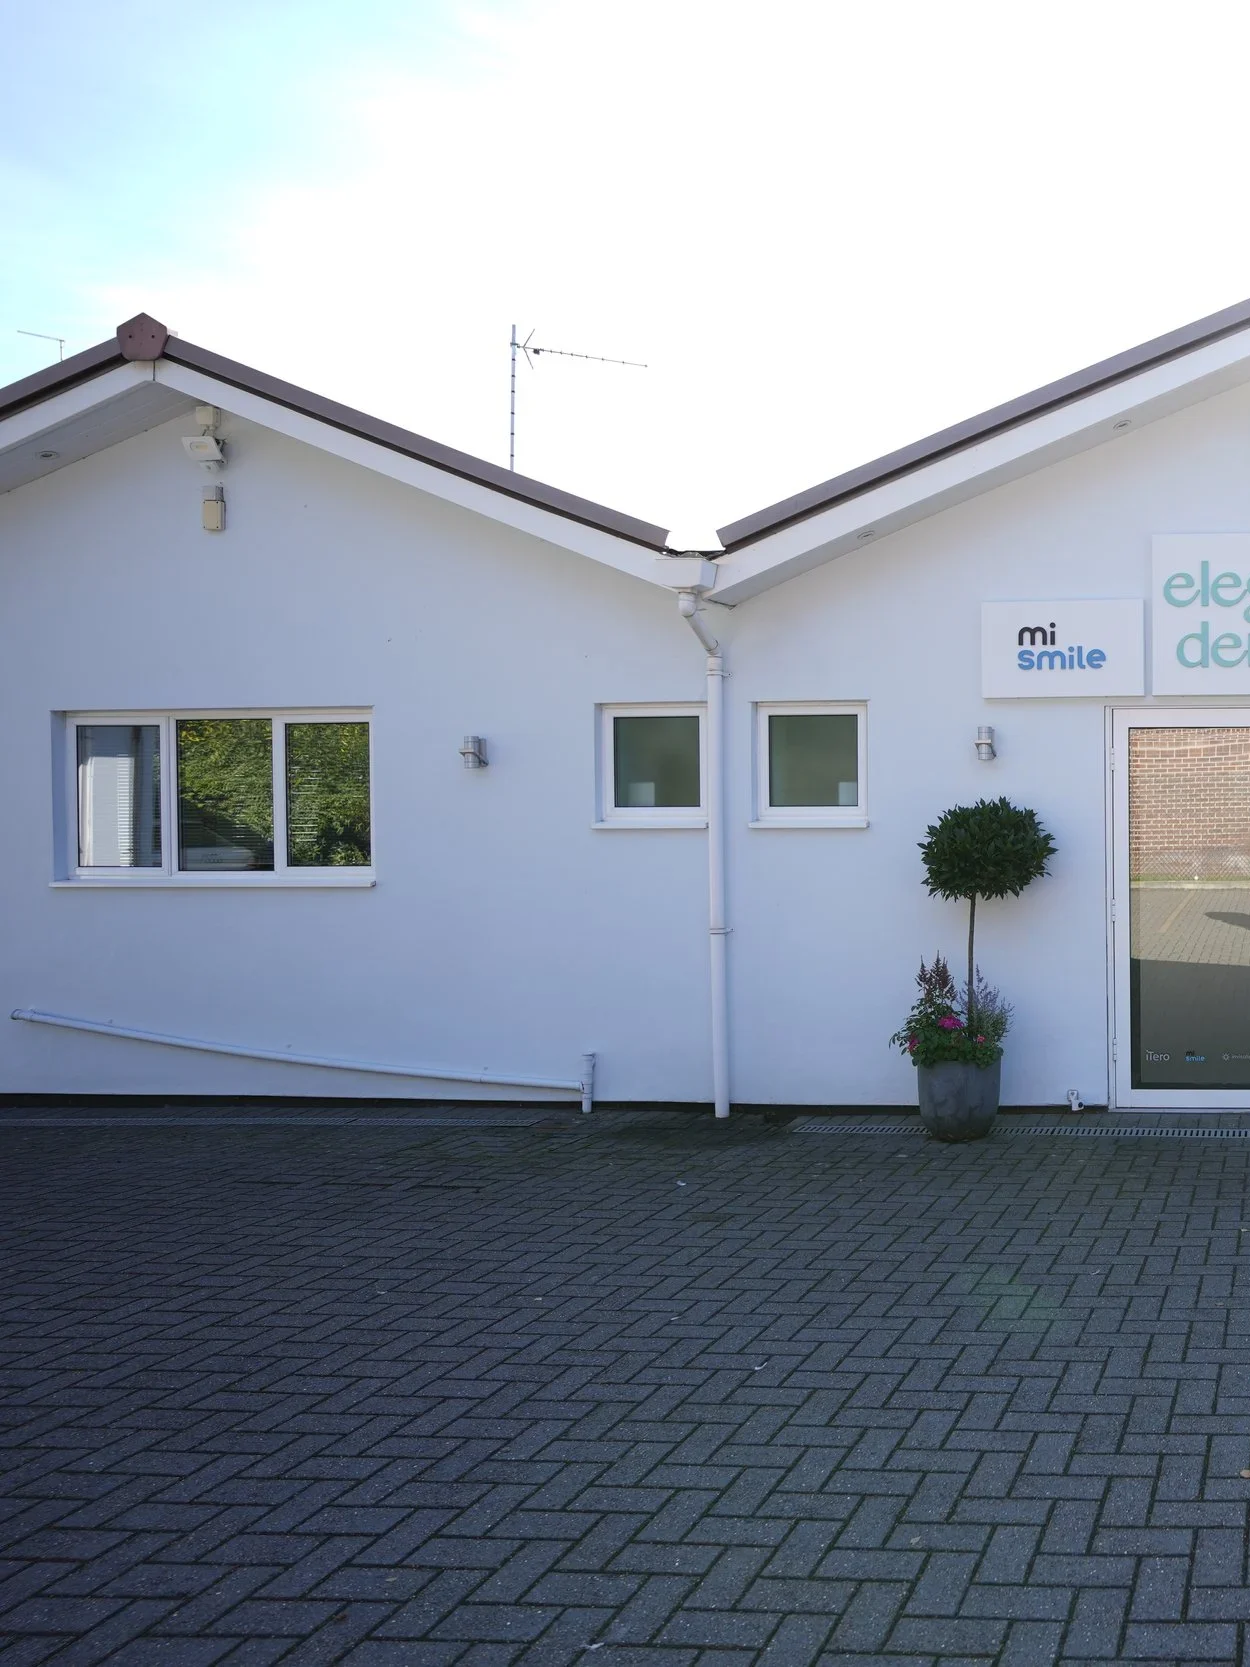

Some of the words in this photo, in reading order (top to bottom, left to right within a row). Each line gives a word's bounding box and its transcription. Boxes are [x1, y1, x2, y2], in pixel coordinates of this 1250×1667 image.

[1018, 622, 1056, 646] mi
[1017, 645, 1107, 671] smile
[1146, 1049, 1170, 1061] iTero
